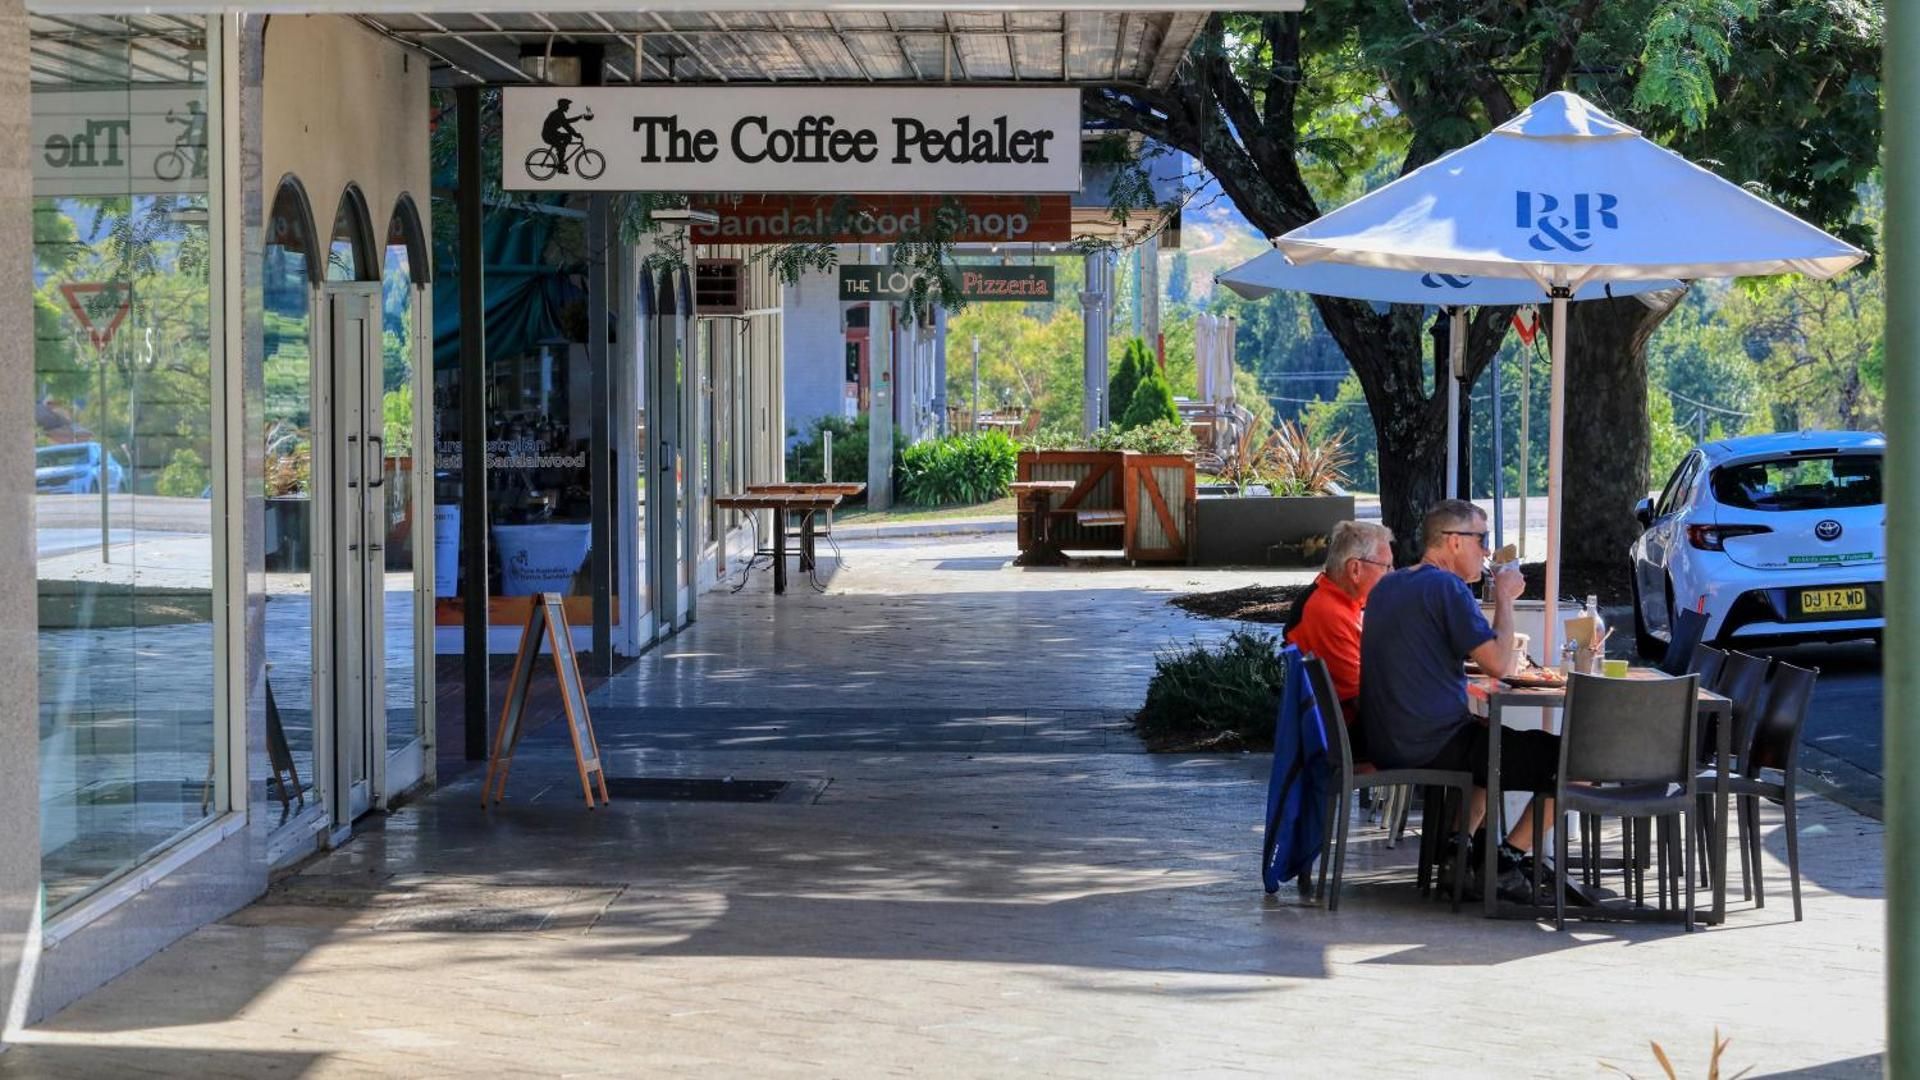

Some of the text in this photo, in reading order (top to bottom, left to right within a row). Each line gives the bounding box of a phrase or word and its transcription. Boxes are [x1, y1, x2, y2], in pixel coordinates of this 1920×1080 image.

[633, 115, 1053, 165] The Coffee Pedaler
[936, 207, 1029, 240] Shop
[845, 271, 1049, 295] THE LOCA Pizzeria
[487, 451, 586, 468] Sandalwood
[1827, 591, 1842, 606] 12
